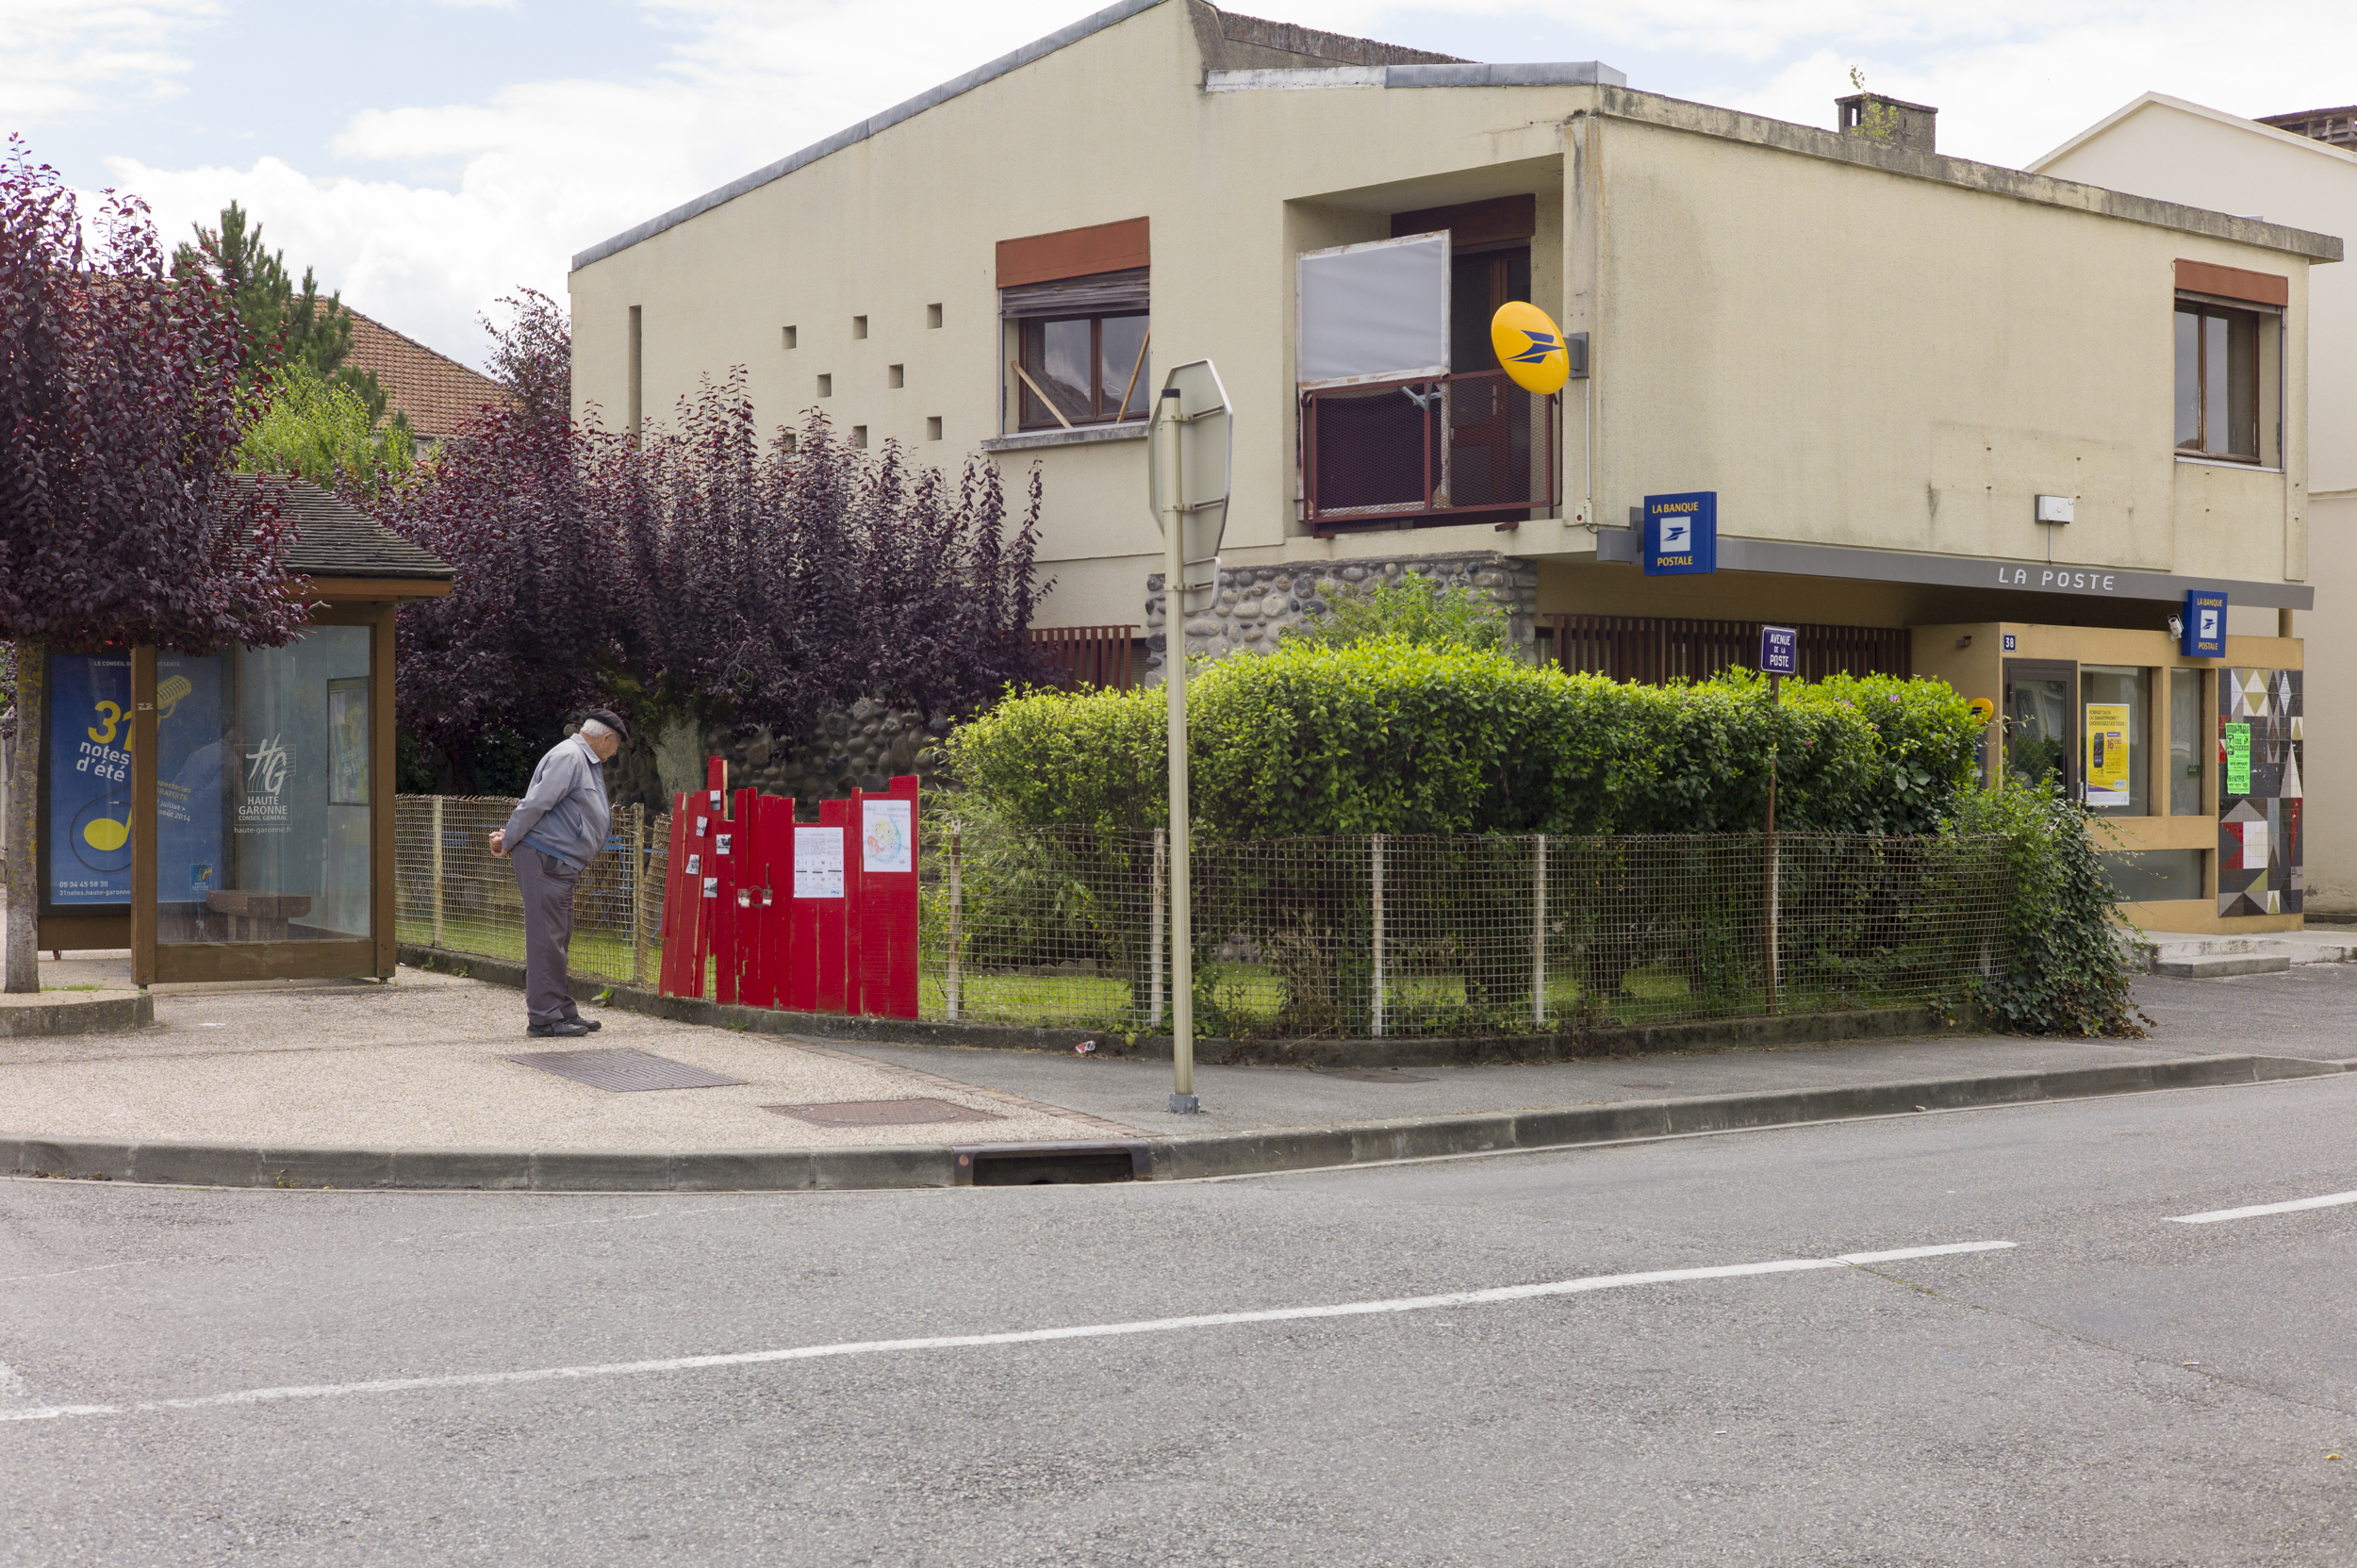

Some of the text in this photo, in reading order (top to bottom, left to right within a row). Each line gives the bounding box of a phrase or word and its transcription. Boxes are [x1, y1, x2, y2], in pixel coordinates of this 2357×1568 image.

[1652, 502, 1699, 514] LA BANQUE
[1656, 555, 1693, 567] POSTALE
[1998, 567, 2115, 591] LA POSTE
[2197, 598, 2223, 608] LA BANQUE
[1770, 633, 1791, 646] AVENUE
[2005, 636, 2015, 649] 38
[1773, 645, 1786, 654] DE LA
[2198, 641, 2218, 651] POSTALE
[1770, 653, 1789, 668] POSTE
[79, 741, 130, 766] notes
[75, 756, 125, 783] d'été
[157, 780, 191, 794] spectacles
[160, 800, 180, 811] juillet
[247, 796, 279, 805] HAUTE
[158, 809, 191, 822] août 2014
[239, 805, 288, 815] GARONNE
[234, 826, 292, 834] haute-garonne.fr
